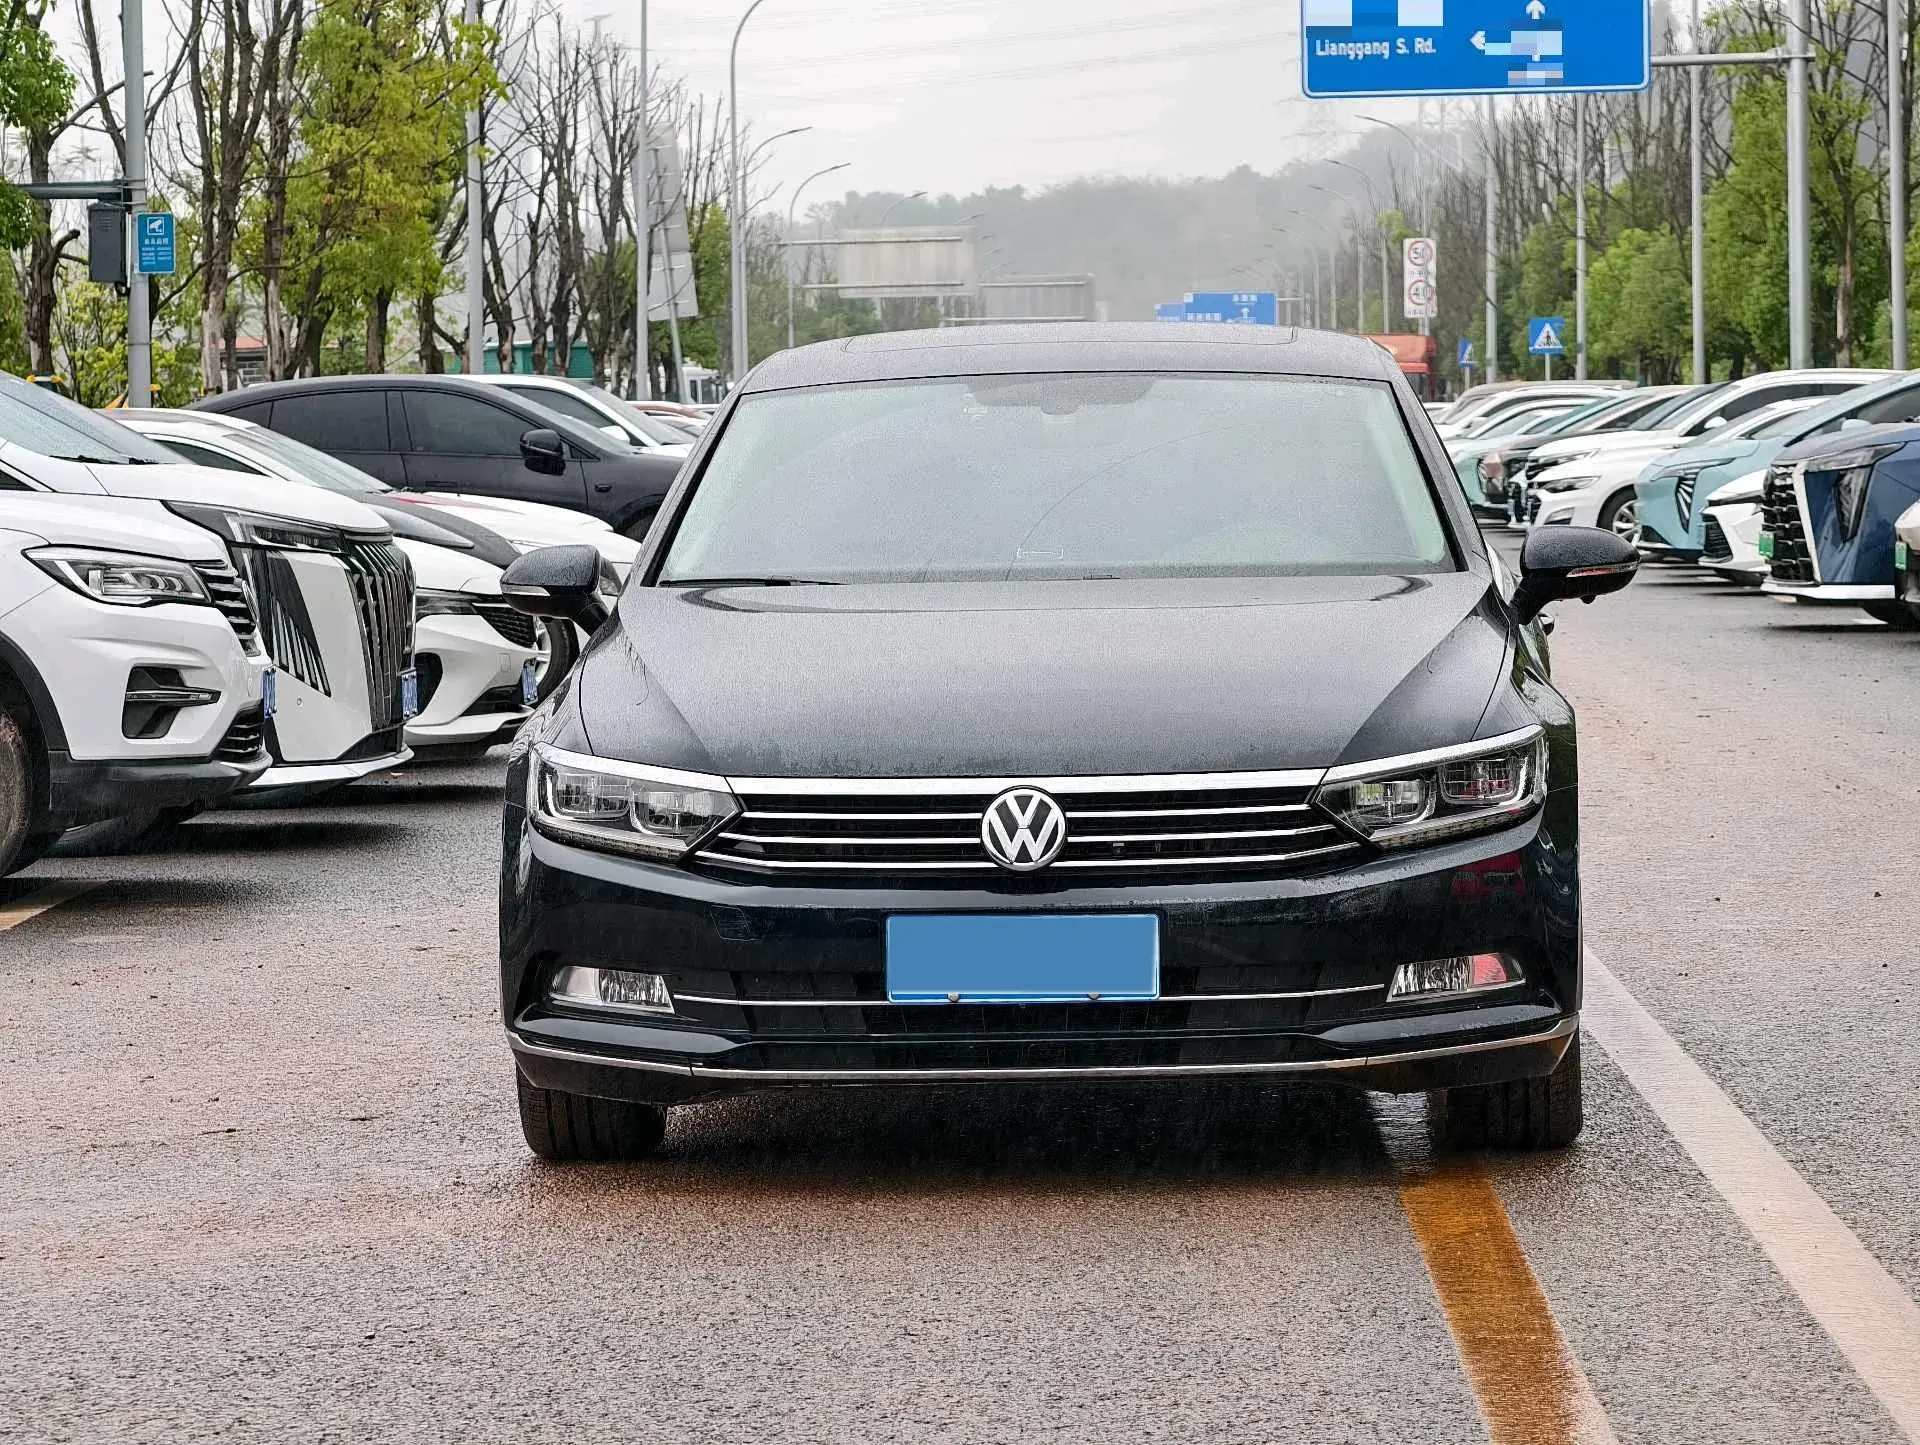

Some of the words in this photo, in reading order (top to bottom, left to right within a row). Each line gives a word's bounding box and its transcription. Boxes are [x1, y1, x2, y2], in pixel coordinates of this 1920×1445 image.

[1315, 40, 1390, 60] Lianggang
[1396, 38, 1410, 55] S.
[1414, 38, 1437, 55] Rd.
